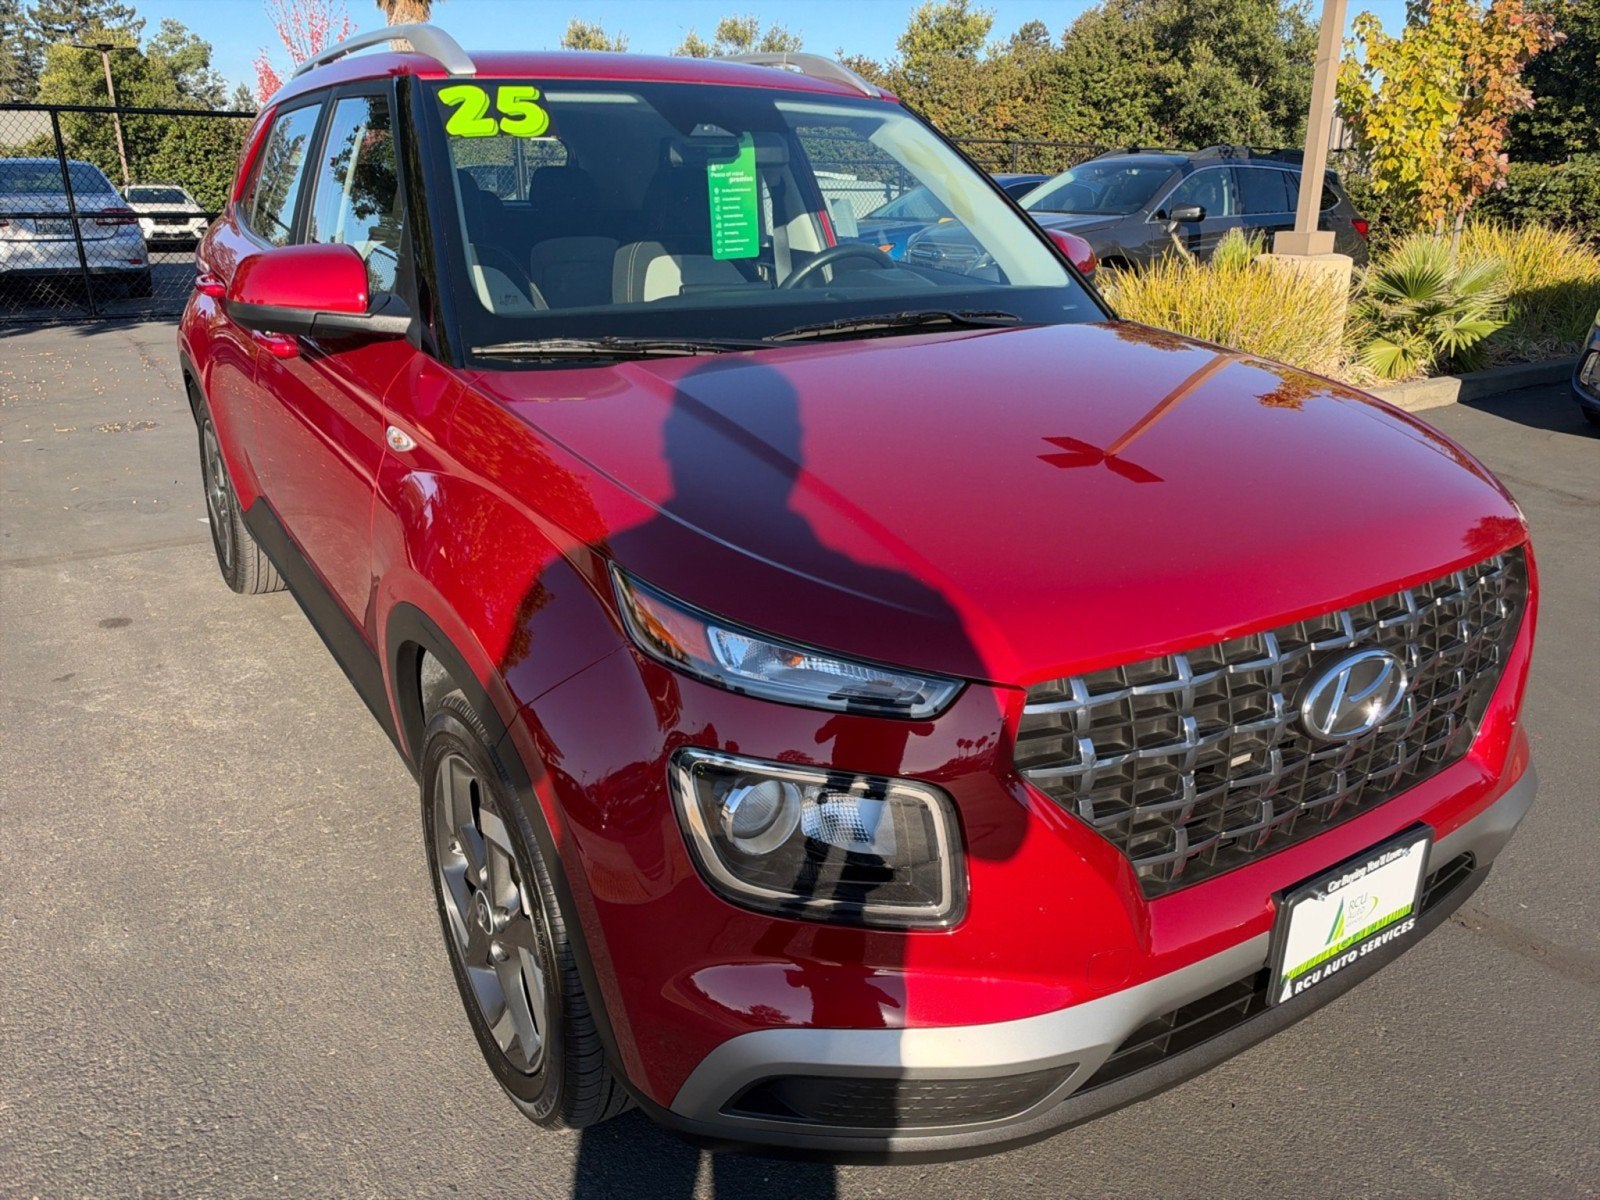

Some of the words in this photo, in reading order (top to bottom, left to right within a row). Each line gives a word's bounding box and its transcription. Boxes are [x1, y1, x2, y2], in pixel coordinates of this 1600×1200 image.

[438, 85, 550, 137] 25
[1294, 969, 1322, 995] RCU
[1323, 949, 1358, 978] AUTO
[1359, 918, 1416, 957] SERVICES
